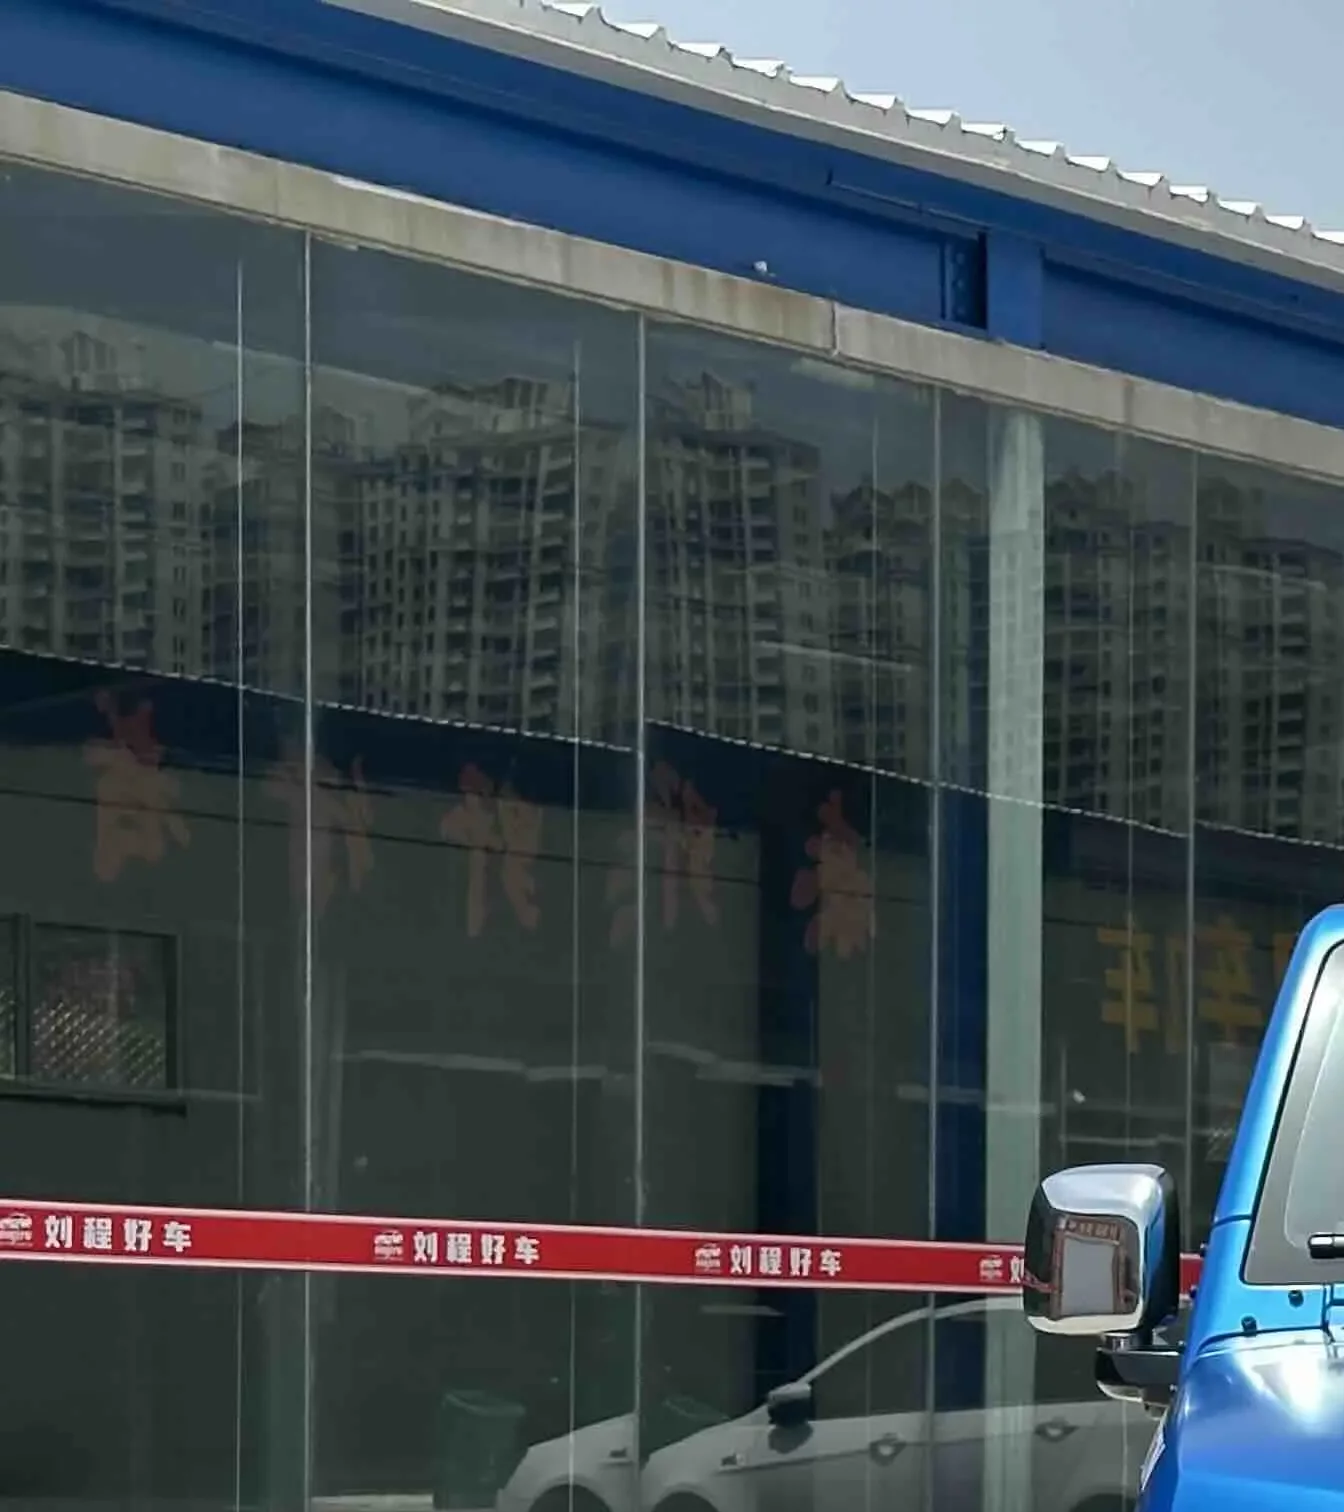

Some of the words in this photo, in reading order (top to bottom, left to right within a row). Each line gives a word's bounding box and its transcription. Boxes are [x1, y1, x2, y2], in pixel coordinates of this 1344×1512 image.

[44, 1214, 192, 1252] 刘程好车
[413, 1230, 541, 1265] 刘程好车
[730, 1244, 842, 1277] 刘程好车
